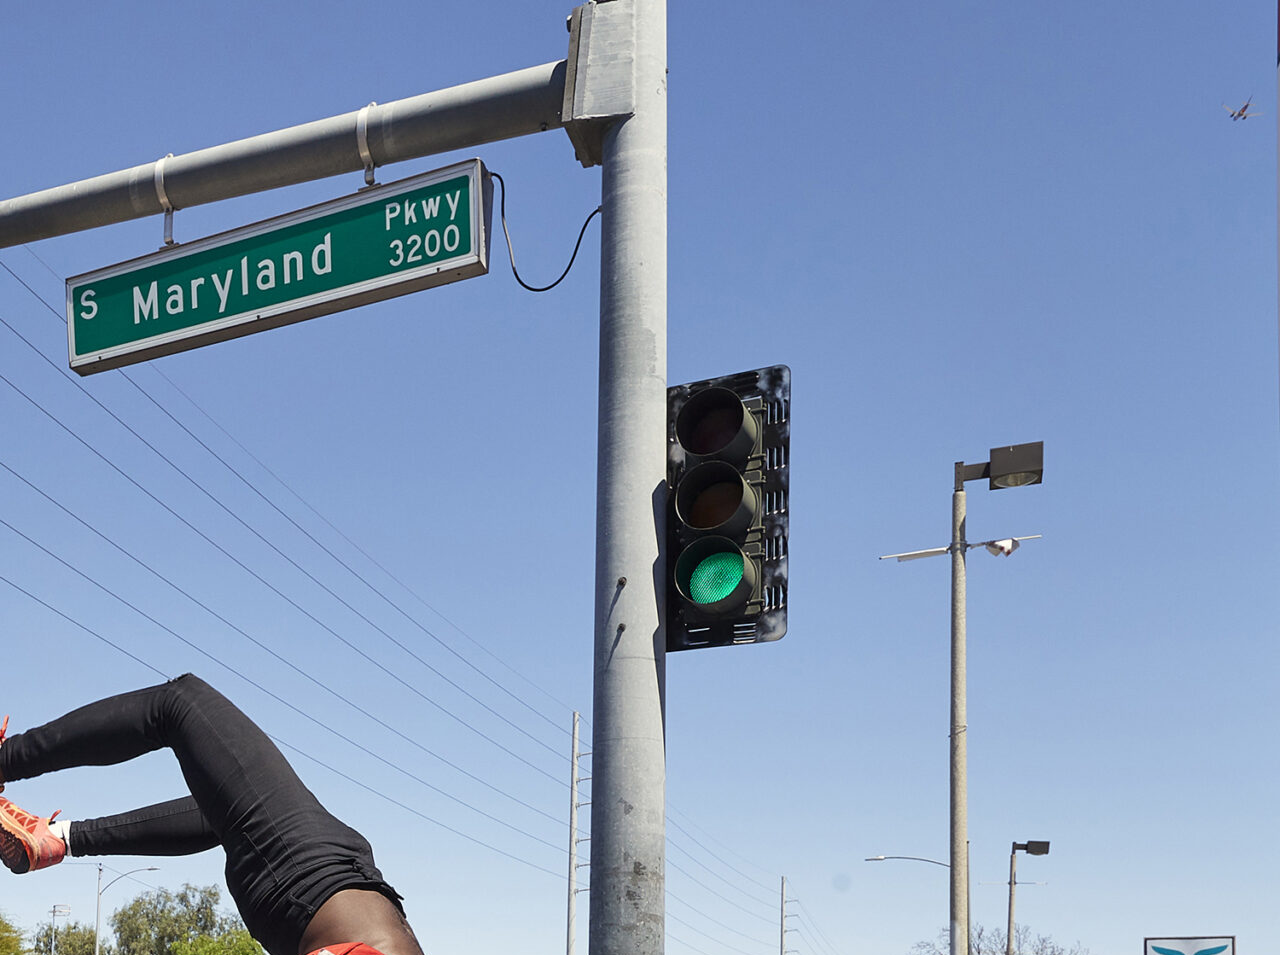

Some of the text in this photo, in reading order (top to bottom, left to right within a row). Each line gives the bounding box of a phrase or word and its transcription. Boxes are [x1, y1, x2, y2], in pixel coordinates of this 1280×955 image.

[384, 189, 462, 231] Pkwy
[388, 224, 461, 267] 3200
[79, 231, 333, 325] S Maryland
